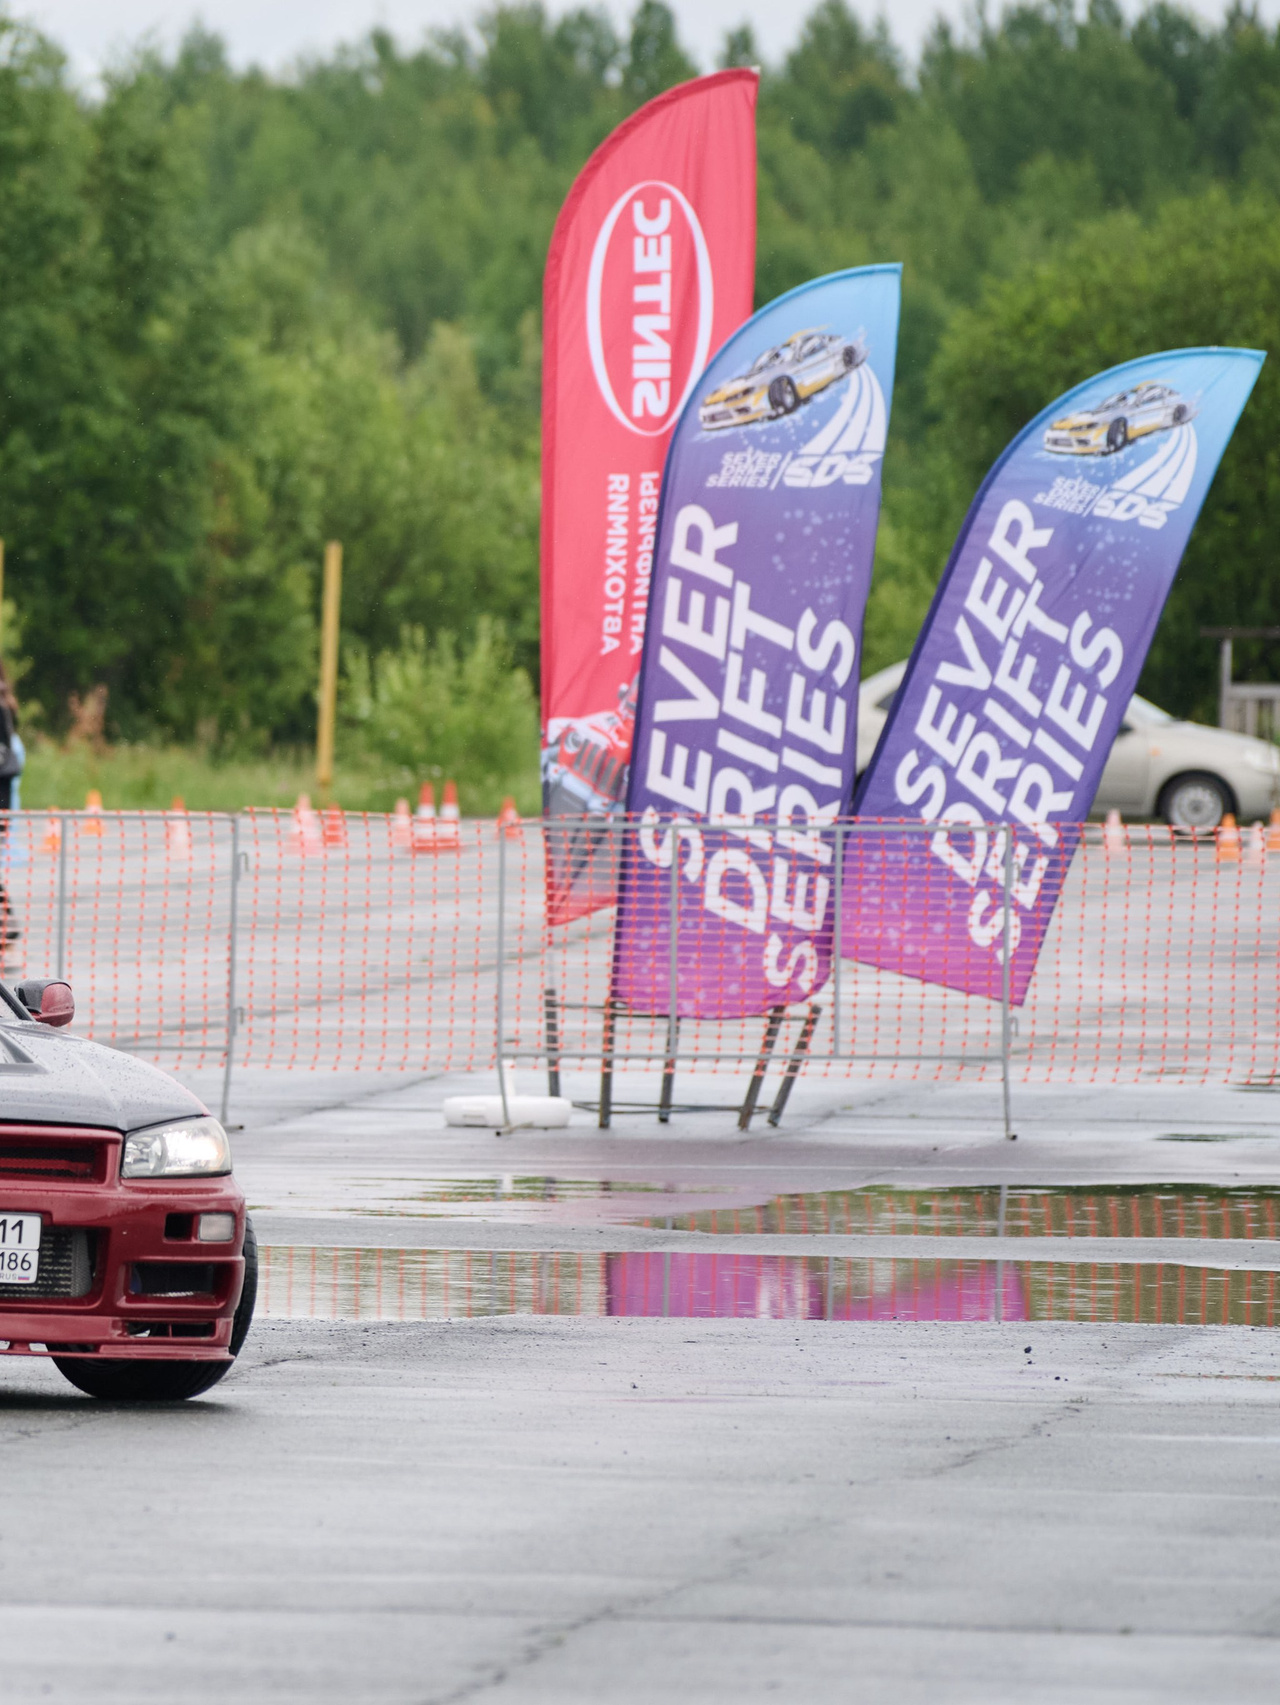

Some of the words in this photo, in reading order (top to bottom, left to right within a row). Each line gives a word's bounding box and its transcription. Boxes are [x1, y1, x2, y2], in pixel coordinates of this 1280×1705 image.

[705, 473, 773, 488] SERIES
[782, 453, 883, 488] SDS
[1092, 489, 1181, 530] SDS
[639, 504, 739, 883] SEVER
[704, 580, 795, 934] DRIFT
[762, 606, 855, 993] SERIES
[894, 499, 1054, 826] SEVER
[930, 578, 1110, 888] DRIFT
[967, 610, 1123, 965] SERIES
[0, 1272, 17, 1280] RUS
